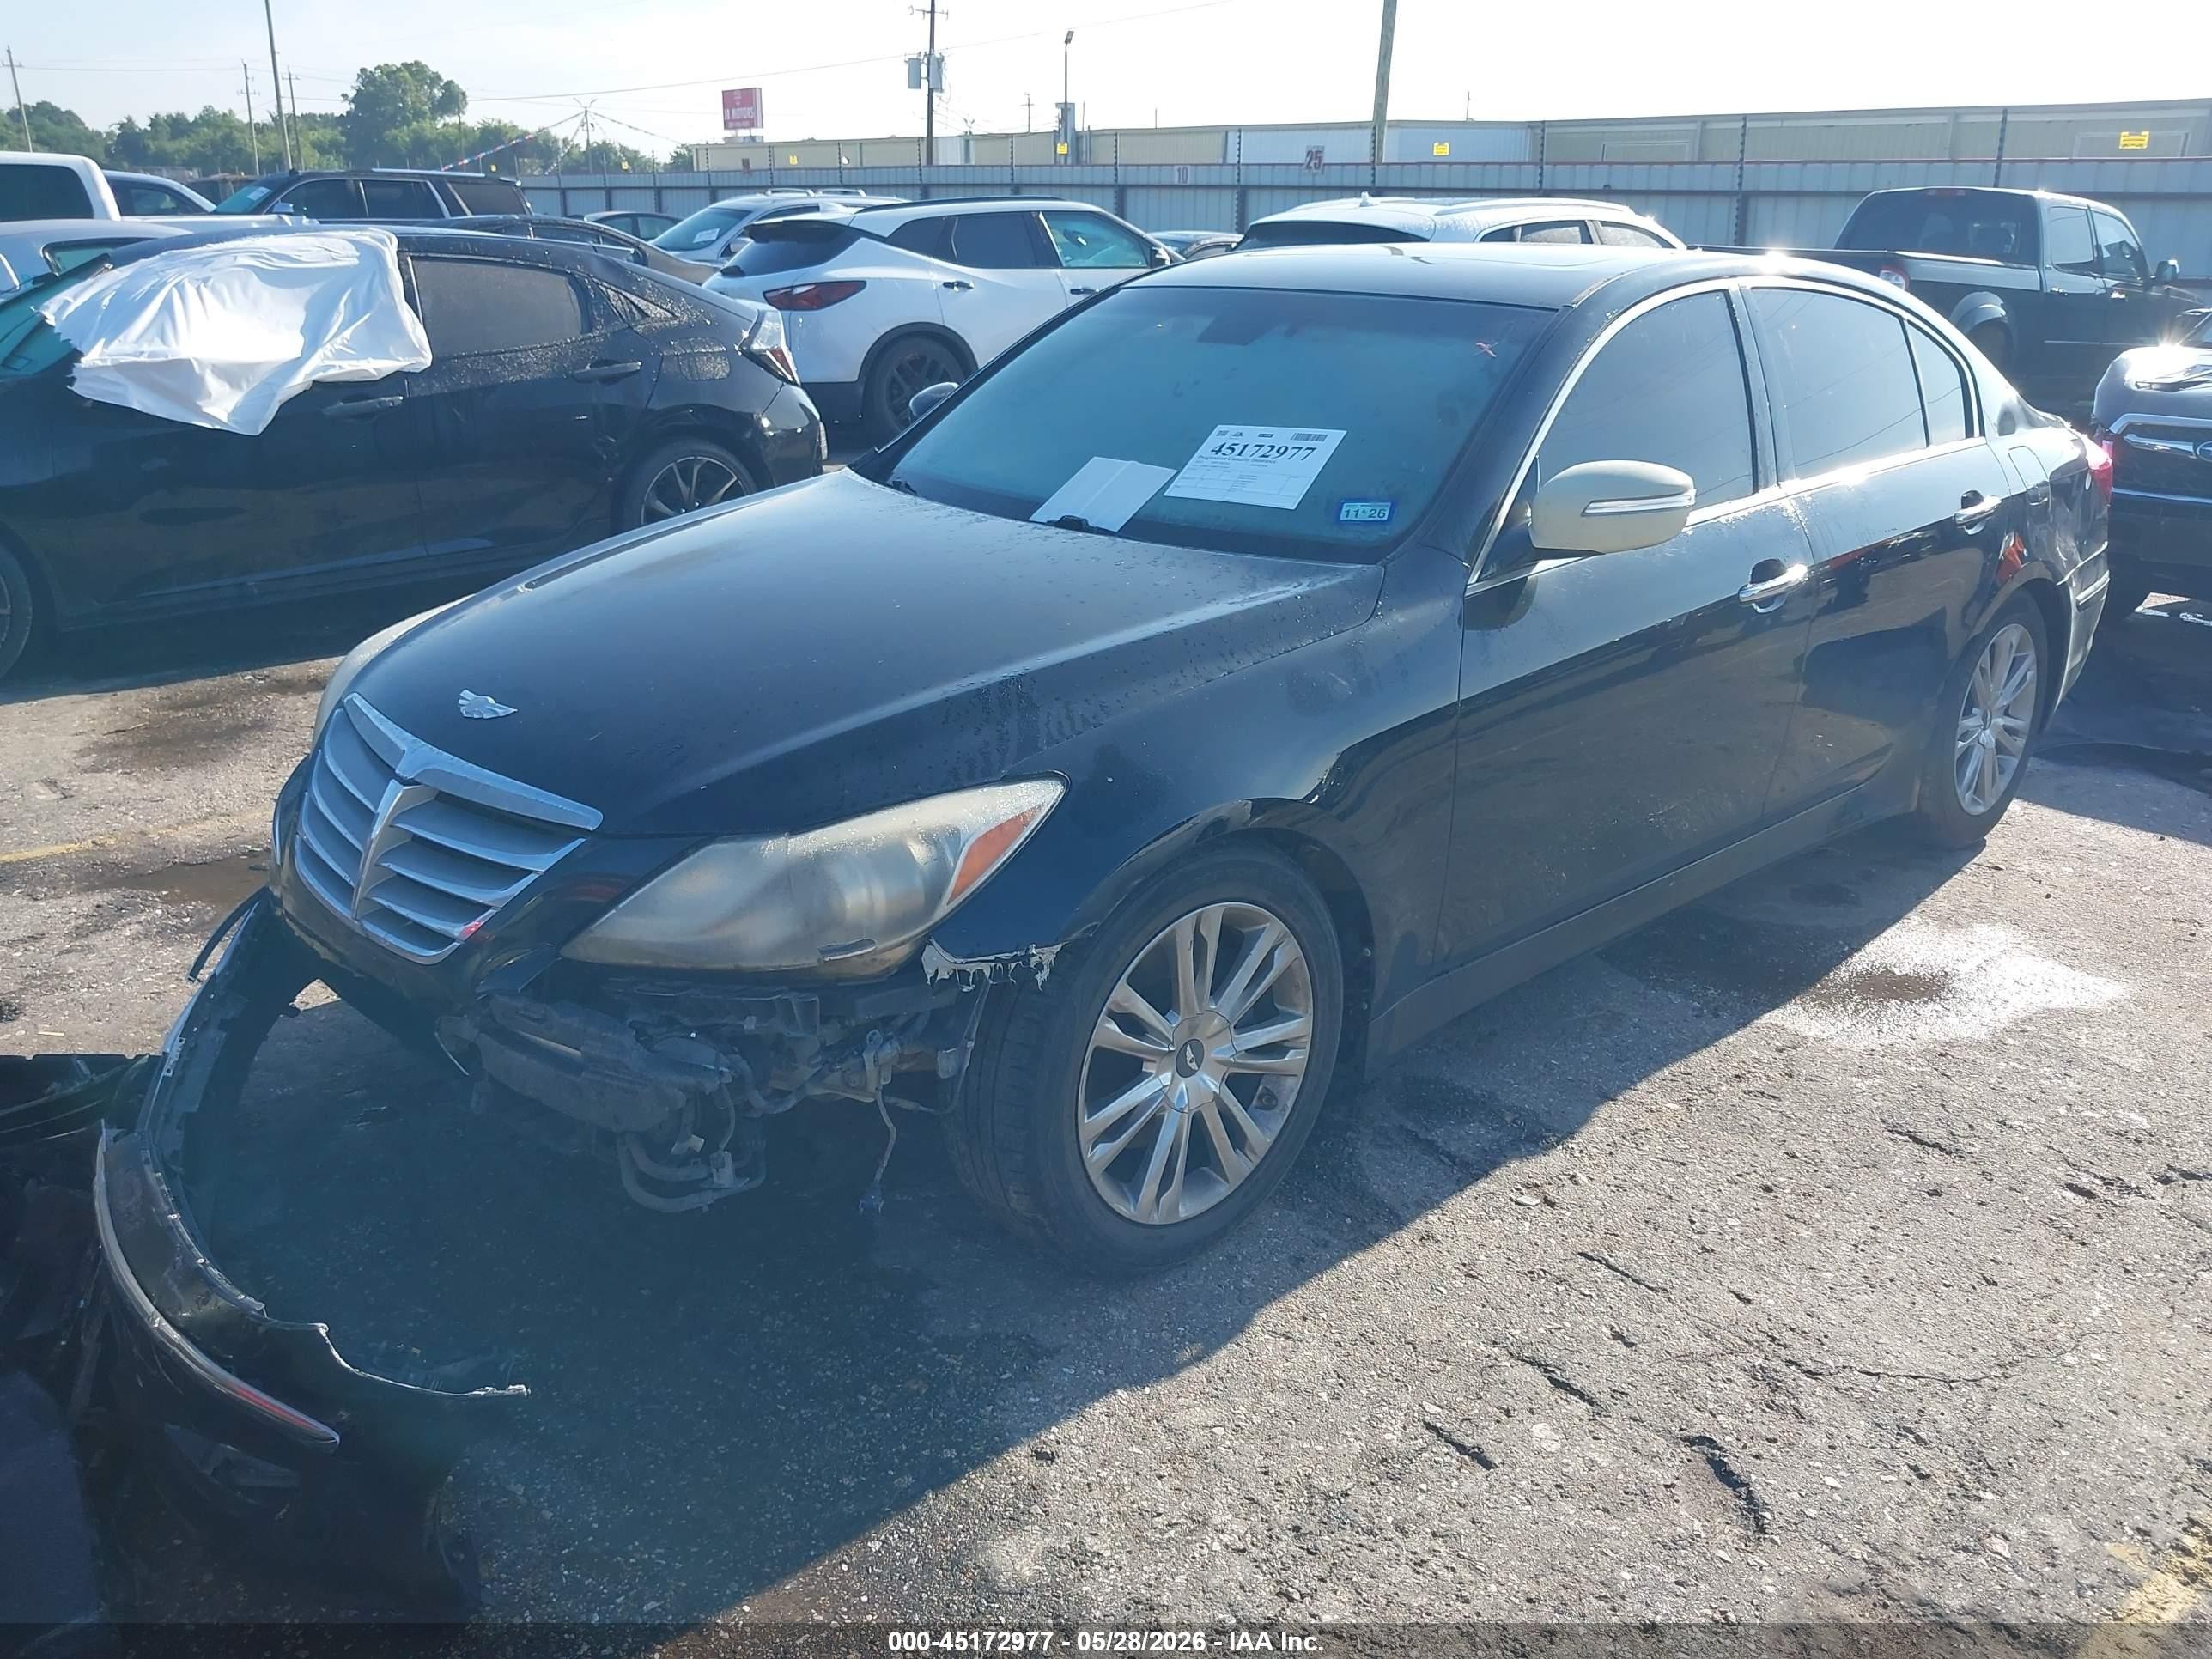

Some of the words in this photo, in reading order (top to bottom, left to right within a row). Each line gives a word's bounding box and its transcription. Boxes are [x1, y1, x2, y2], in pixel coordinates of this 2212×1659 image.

[1305, 150, 1322, 170] 25
[1177, 167, 1188, 184] 10
[1210, 442, 1317, 460] 45172977
